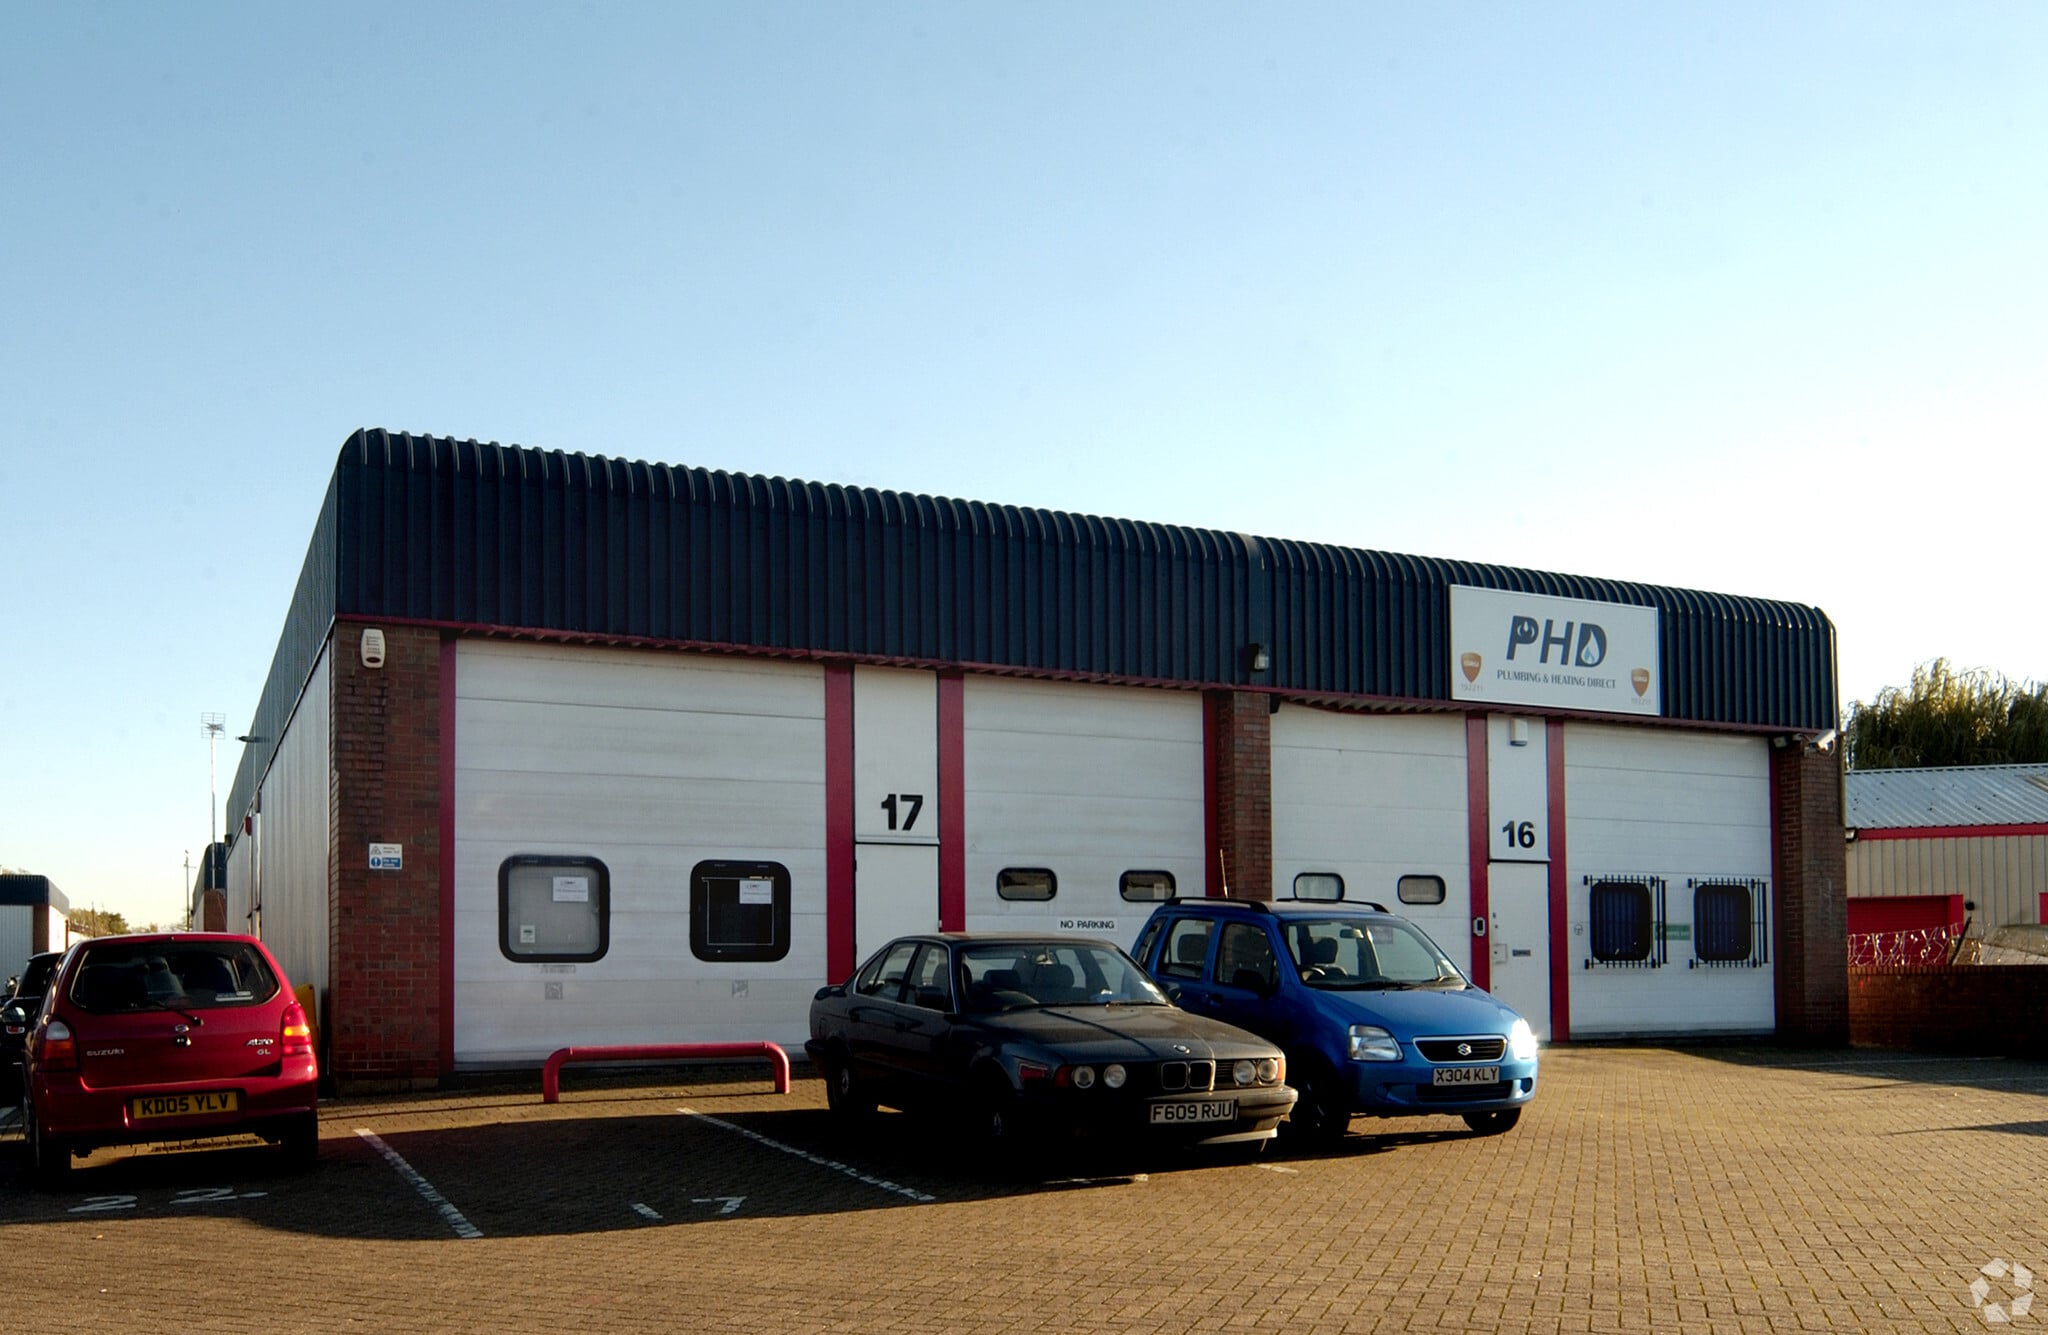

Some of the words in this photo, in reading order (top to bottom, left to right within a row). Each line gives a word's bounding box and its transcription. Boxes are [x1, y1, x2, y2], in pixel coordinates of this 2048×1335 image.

[1506, 615, 1607, 668] PHD
[1497, 669, 1541, 683] PLUMBING
[1543, 673, 1549, 683] &
[1551, 674, 1586, 687] HEATING
[1587, 677, 1616, 689] DIRECT
[881, 794, 923, 831] 17
[1502, 820, 1536, 848] 16
[1060, 920, 1074, 928] NO
[1077, 920, 1114, 929] PARKING
[1435, 1068, 1471, 1082] X304
[1473, 1067, 1498, 1081] KLY
[142, 1096, 189, 1115] KD05
[195, 1094, 228, 1111] YLV
[1153, 1104, 1197, 1120] F609
[1201, 1103, 1231, 1119] RUU
